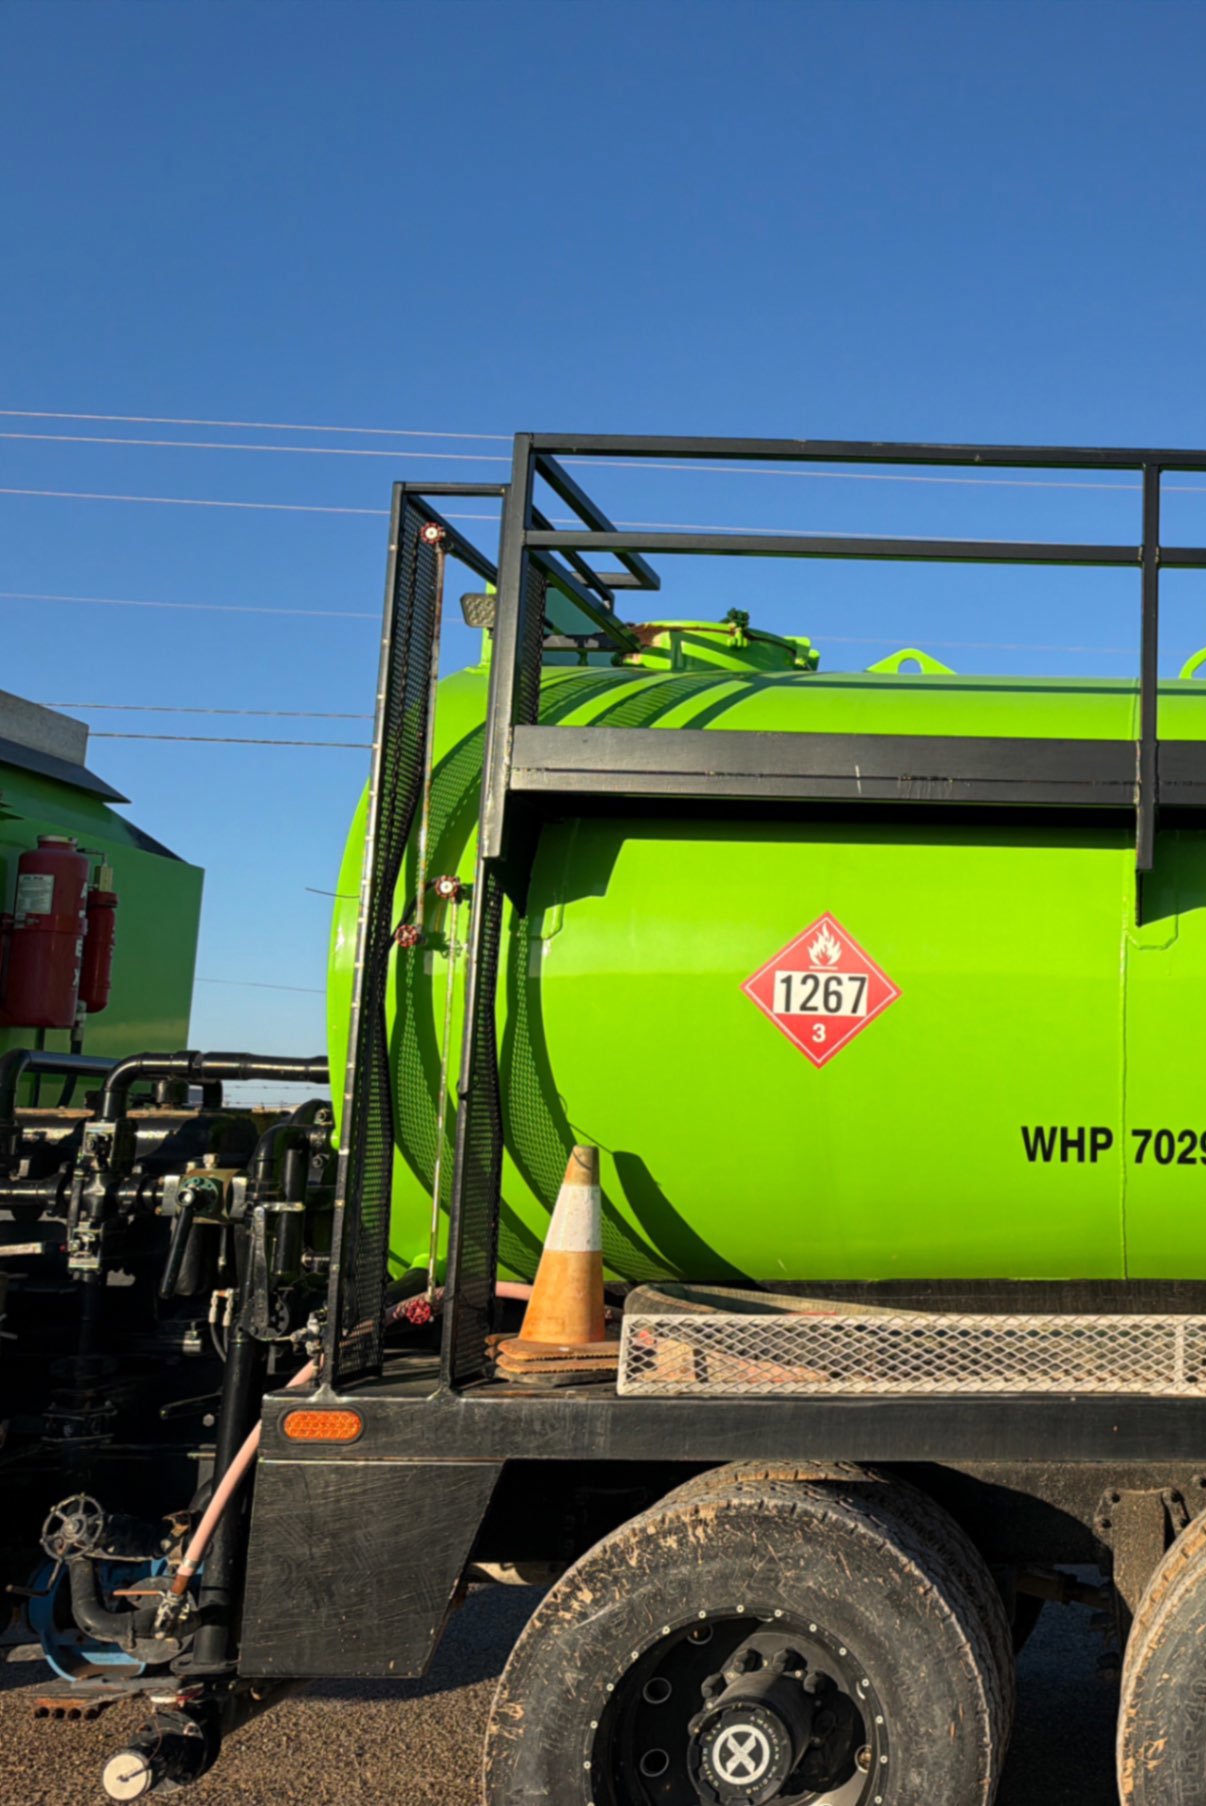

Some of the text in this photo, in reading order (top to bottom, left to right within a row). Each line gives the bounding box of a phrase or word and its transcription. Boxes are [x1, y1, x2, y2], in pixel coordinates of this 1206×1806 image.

[780, 974, 867, 1014] 1267
[811, 1023, 826, 1043] 3
[1021, 1126, 1113, 1163] WHP
